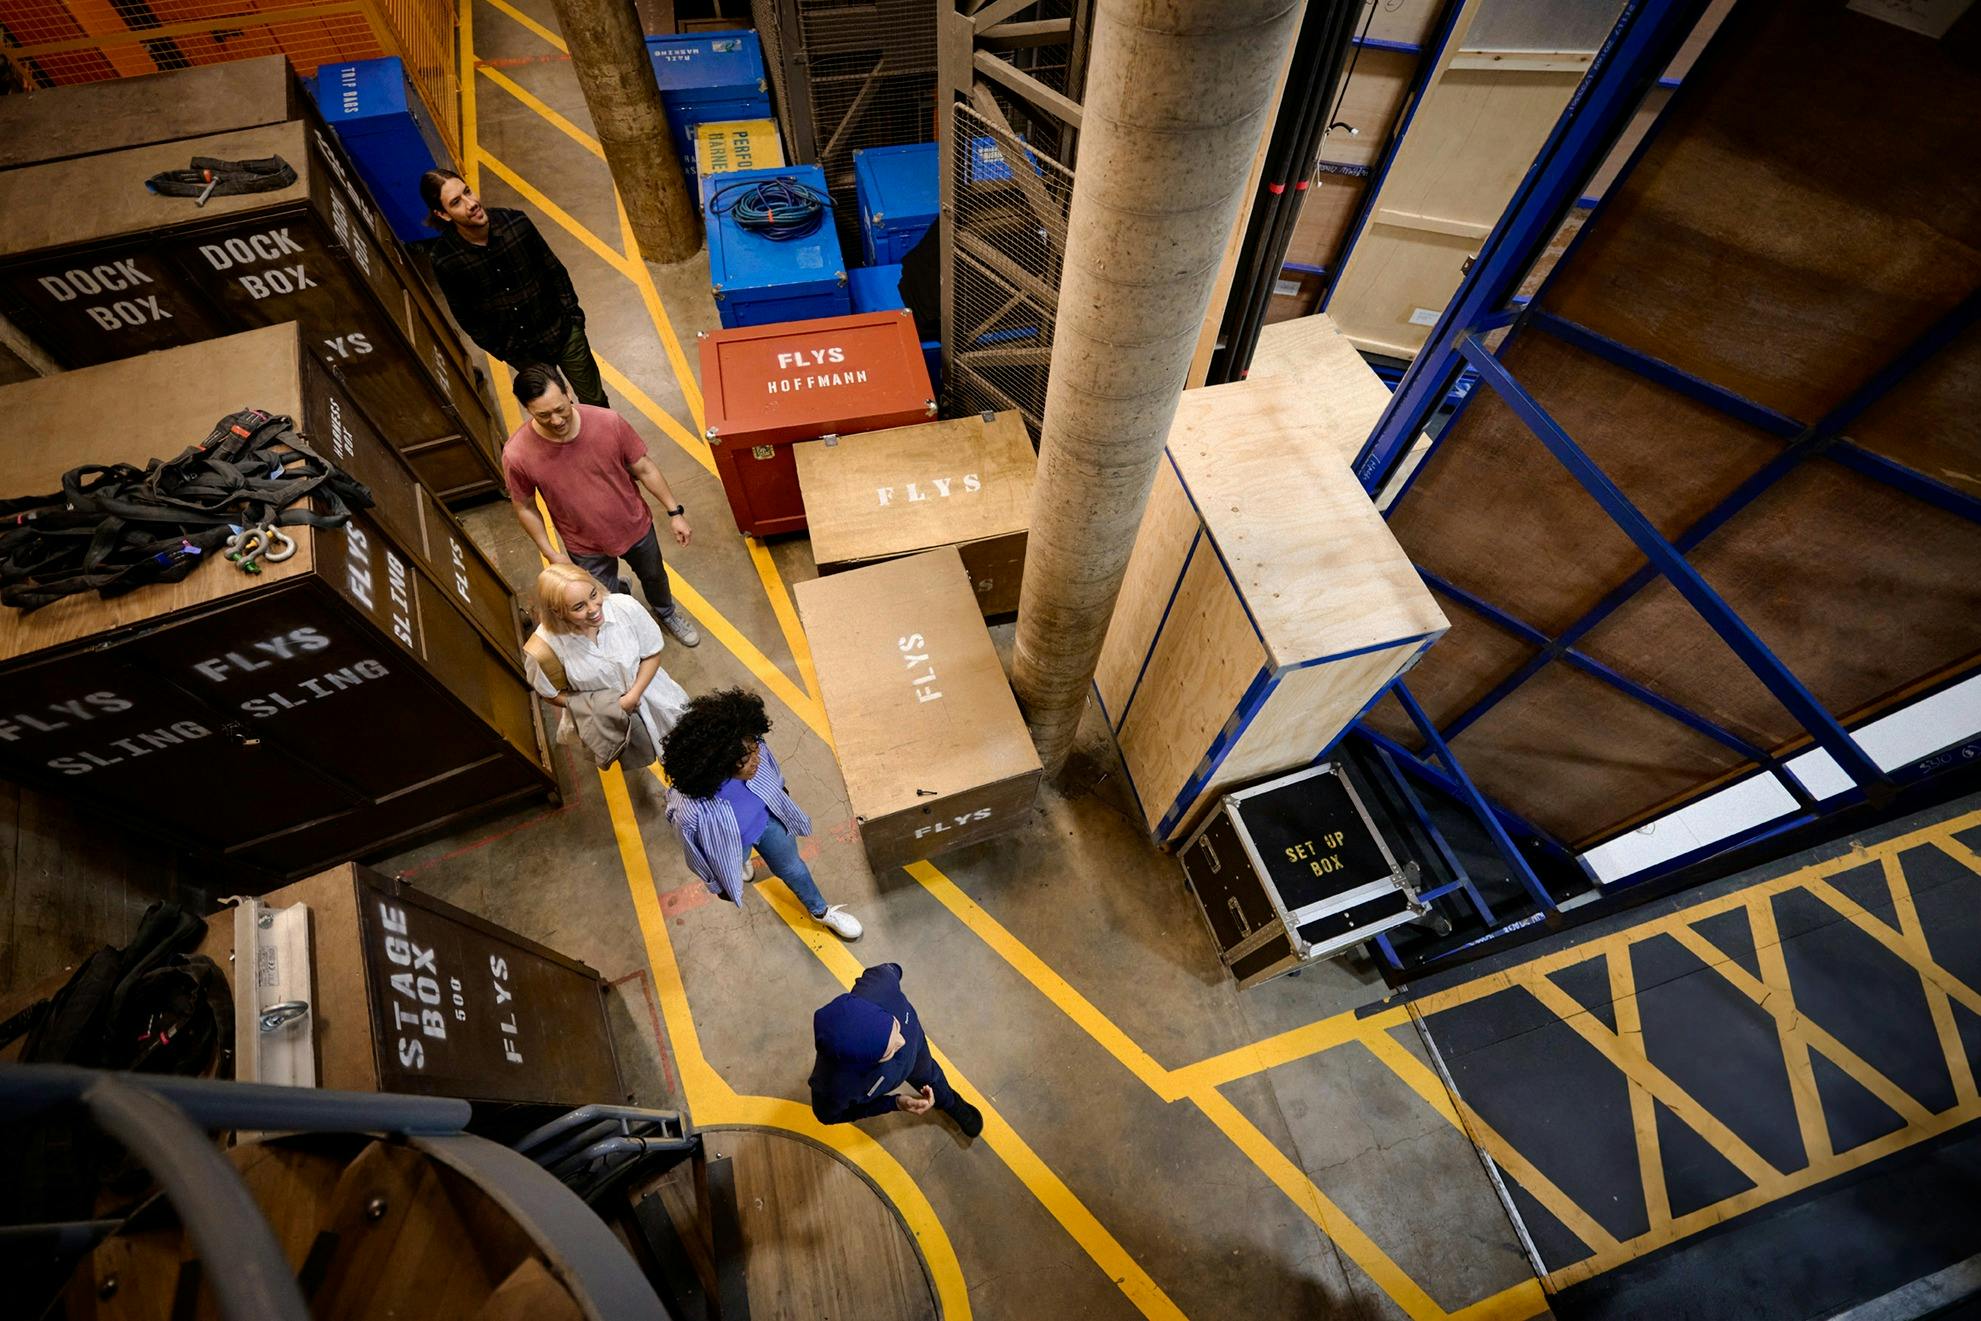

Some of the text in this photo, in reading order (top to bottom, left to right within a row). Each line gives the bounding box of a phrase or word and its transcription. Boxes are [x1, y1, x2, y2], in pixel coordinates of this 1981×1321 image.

[341, 67, 359, 113] TRIP BAGS
[329, 187, 351, 251] DOCK
[198, 228, 304, 271] DOCK
[351, 226, 370, 276] BOX
[37, 258, 154, 302] DOCK
[238, 264, 318, 300] BOX
[85, 295, 174, 331] BOX
[324, 332, 374, 362] YS
[777, 347, 845, 369] FLYS
[767, 370, 868, 394] HOFFMANN
[329, 397, 344, 460] HARNESS
[342, 426, 355, 458] BOX
[876, 473, 982, 507] FLYS
[346, 520, 374, 611] FLYS
[448, 536, 471, 604] FLYS
[386, 551, 413, 649] SLING
[192, 626, 331, 683] FLYS
[898, 632, 943, 704] FLYS
[240, 658, 391, 719] SLING
[0, 690, 134, 742] FLYS
[47, 720, 213, 776] SLING
[914, 807, 992, 840] FLYS
[1285, 831, 1344, 864] SET UP
[1310, 854, 1344, 878] BOX
[379, 902, 425, 1071] STAGE
[411, 942, 447, 1040] BOX
[450, 976, 466, 1022] 500
[489, 955, 524, 1064] FLYS
